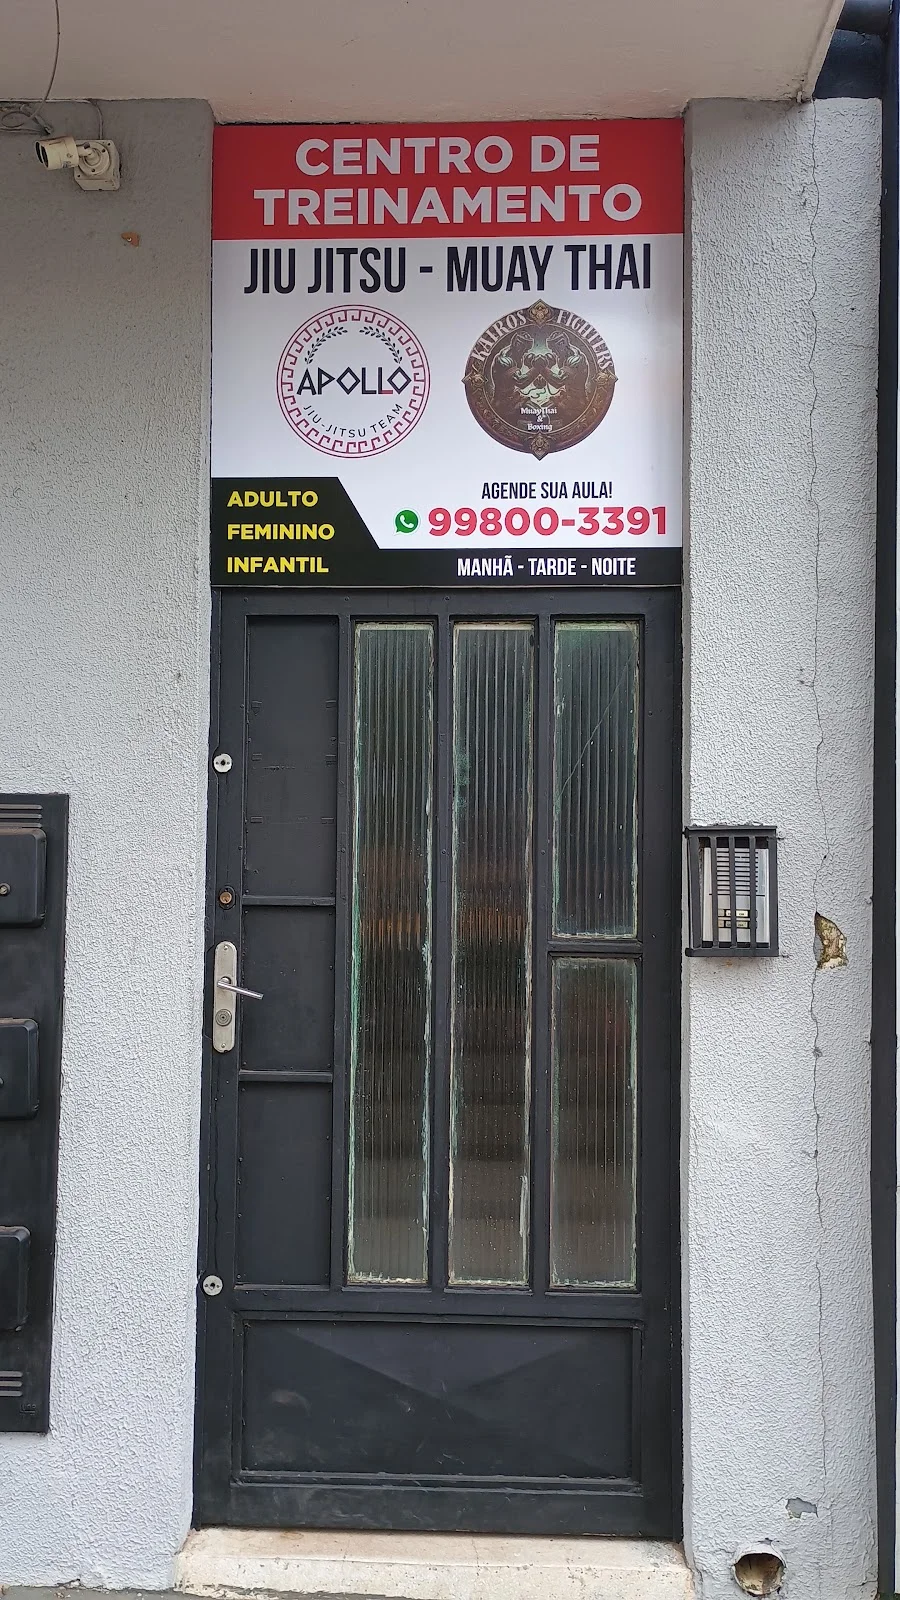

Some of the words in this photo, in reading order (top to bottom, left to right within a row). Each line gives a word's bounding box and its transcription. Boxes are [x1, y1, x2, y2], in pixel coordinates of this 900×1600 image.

[295, 135, 514, 176] CENTRO
[530, 134, 601, 173] DE
[253, 183, 642, 226] TREINAMENTO
[243, 248, 296, 294] JIU
[307, 246, 406, 294] JITSU
[419, 265, 433, 274] -
[446, 244, 554, 292] MUAY
[564, 243, 652, 290] THAI
[470, 309, 528, 363] KAIROS
[556, 308, 614, 370] FIGHTERS
[296, 366, 413, 396] APOLLO
[303, 404, 367, 439] JIU-JITSU
[370, 403, 404, 434] TEAM
[527, 423, 553, 431] Boxing
[226, 490, 319, 508] ADULTO
[481, 482, 537, 500] AGENDE
[540, 481, 569, 499] SUA
[571, 481, 613, 499] AULA!
[227, 523, 335, 541] FEMININO
[428, 506, 667, 537] 99800-3391
[227, 556, 329, 573] INFANTIL
[457, 555, 514, 577] MANHÃ
[528, 557, 577, 576] TARDE
[591, 557, 637, 576] NOITE
